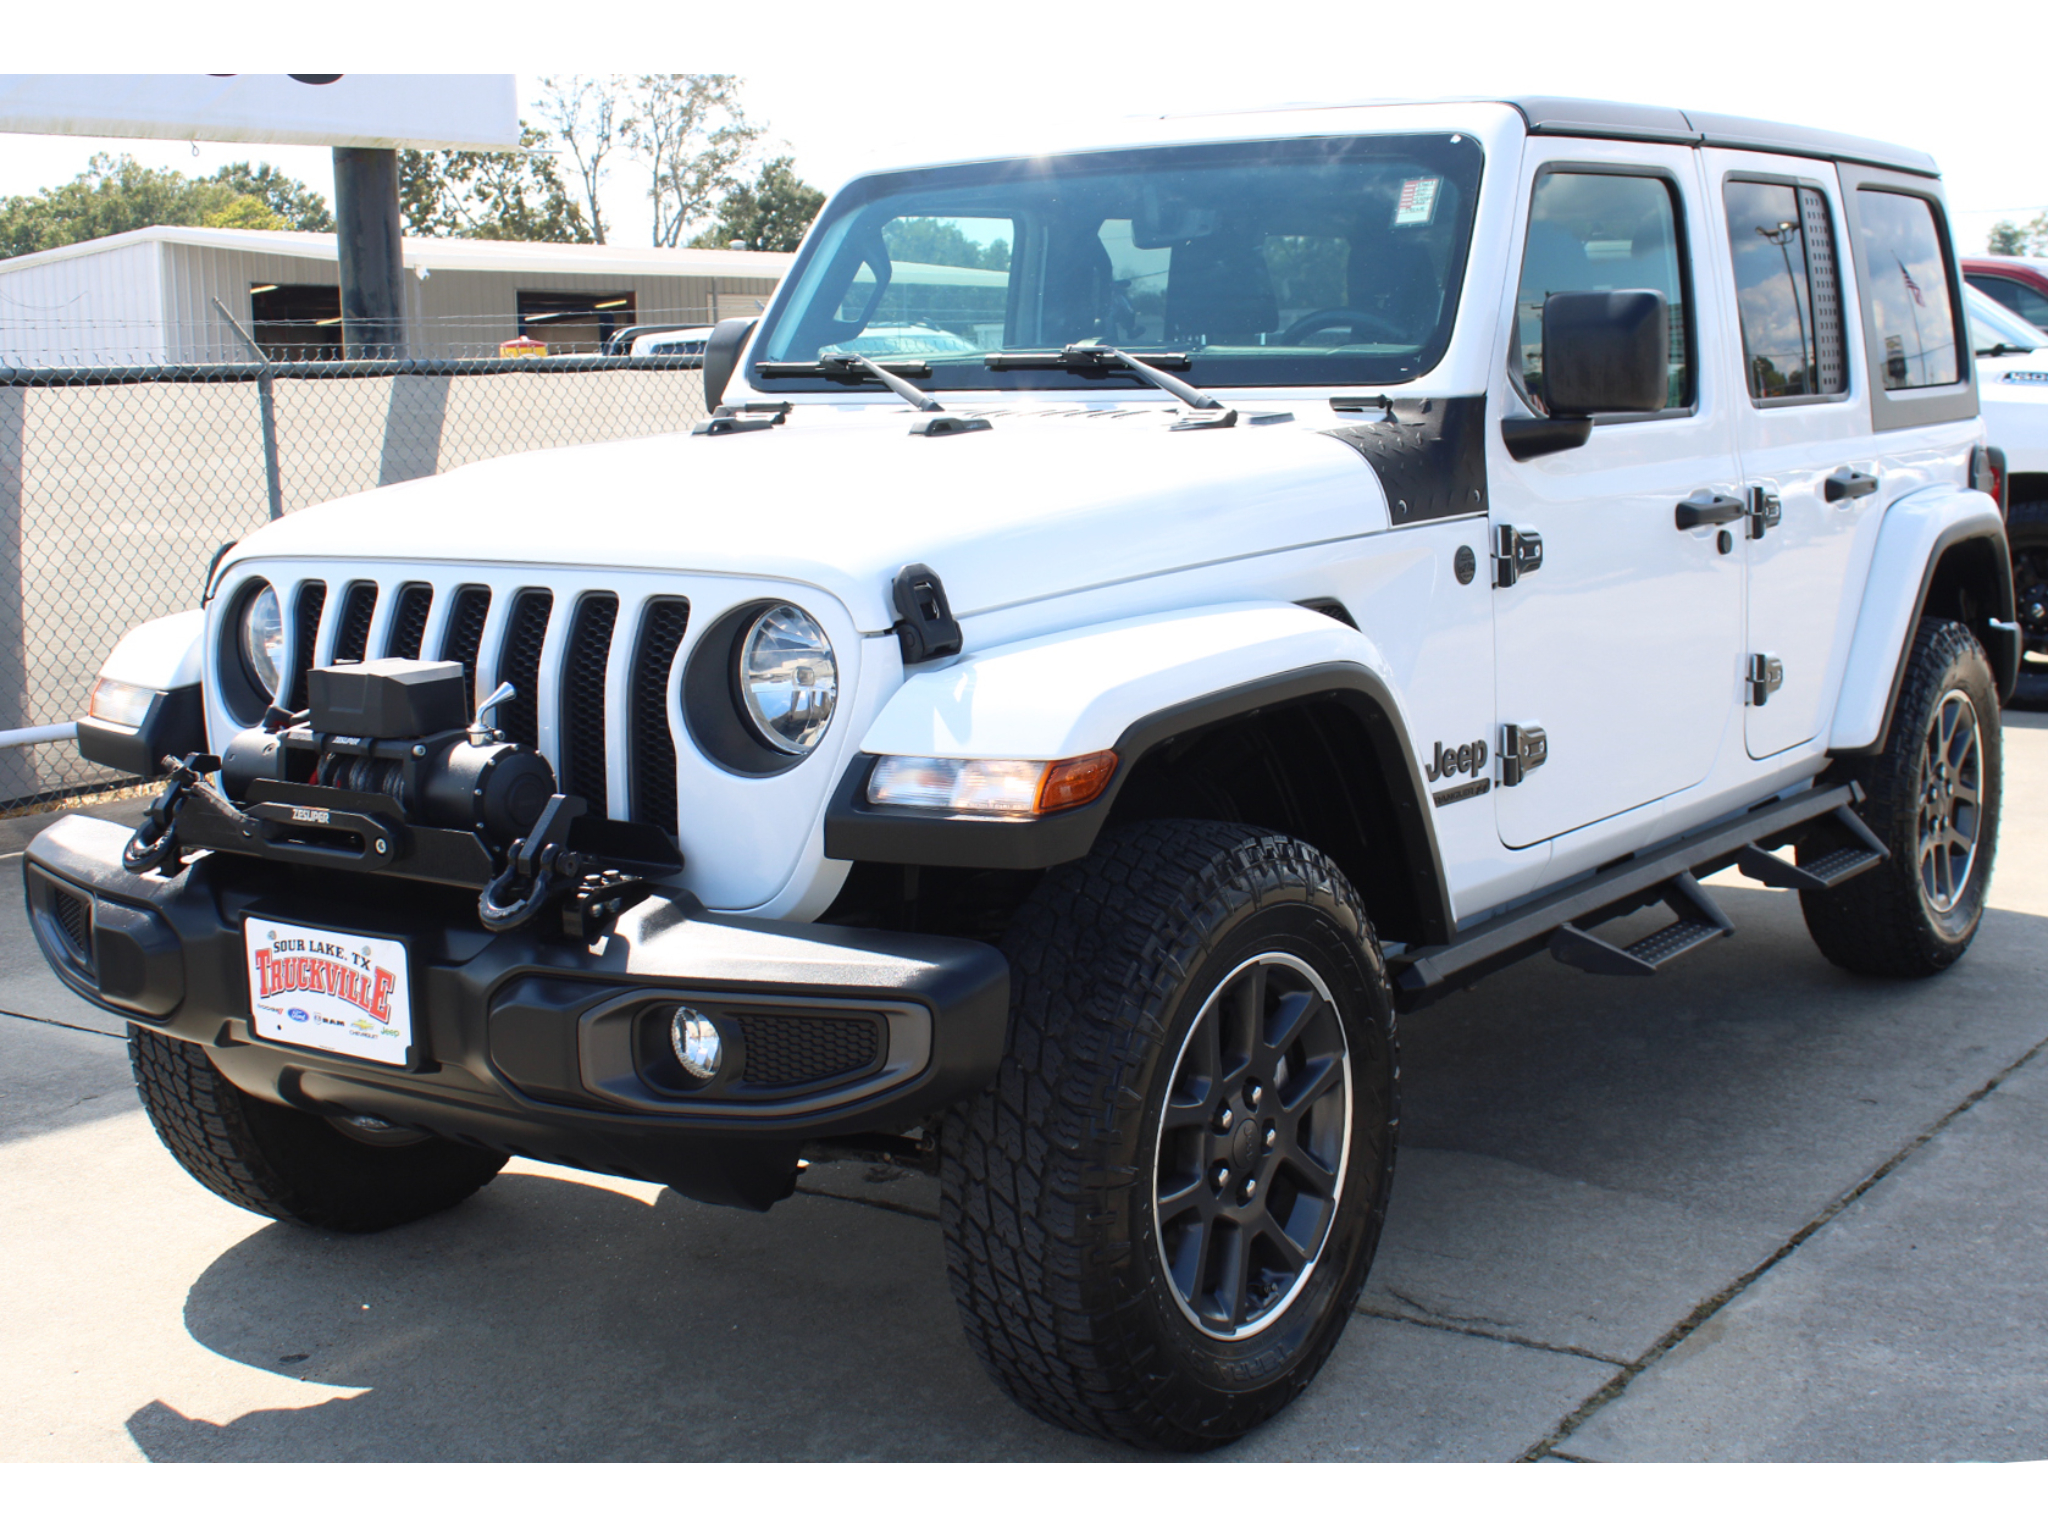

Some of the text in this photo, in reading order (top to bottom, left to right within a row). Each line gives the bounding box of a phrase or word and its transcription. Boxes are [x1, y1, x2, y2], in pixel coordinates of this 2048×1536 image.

[1425, 739, 1488, 782] Jeep
[273, 939, 305, 953] SOUR
[351, 952, 372, 972] TX
[255, 948, 396, 1025] TRUCKVILLE
[322, 1016, 345, 1027] RAM
